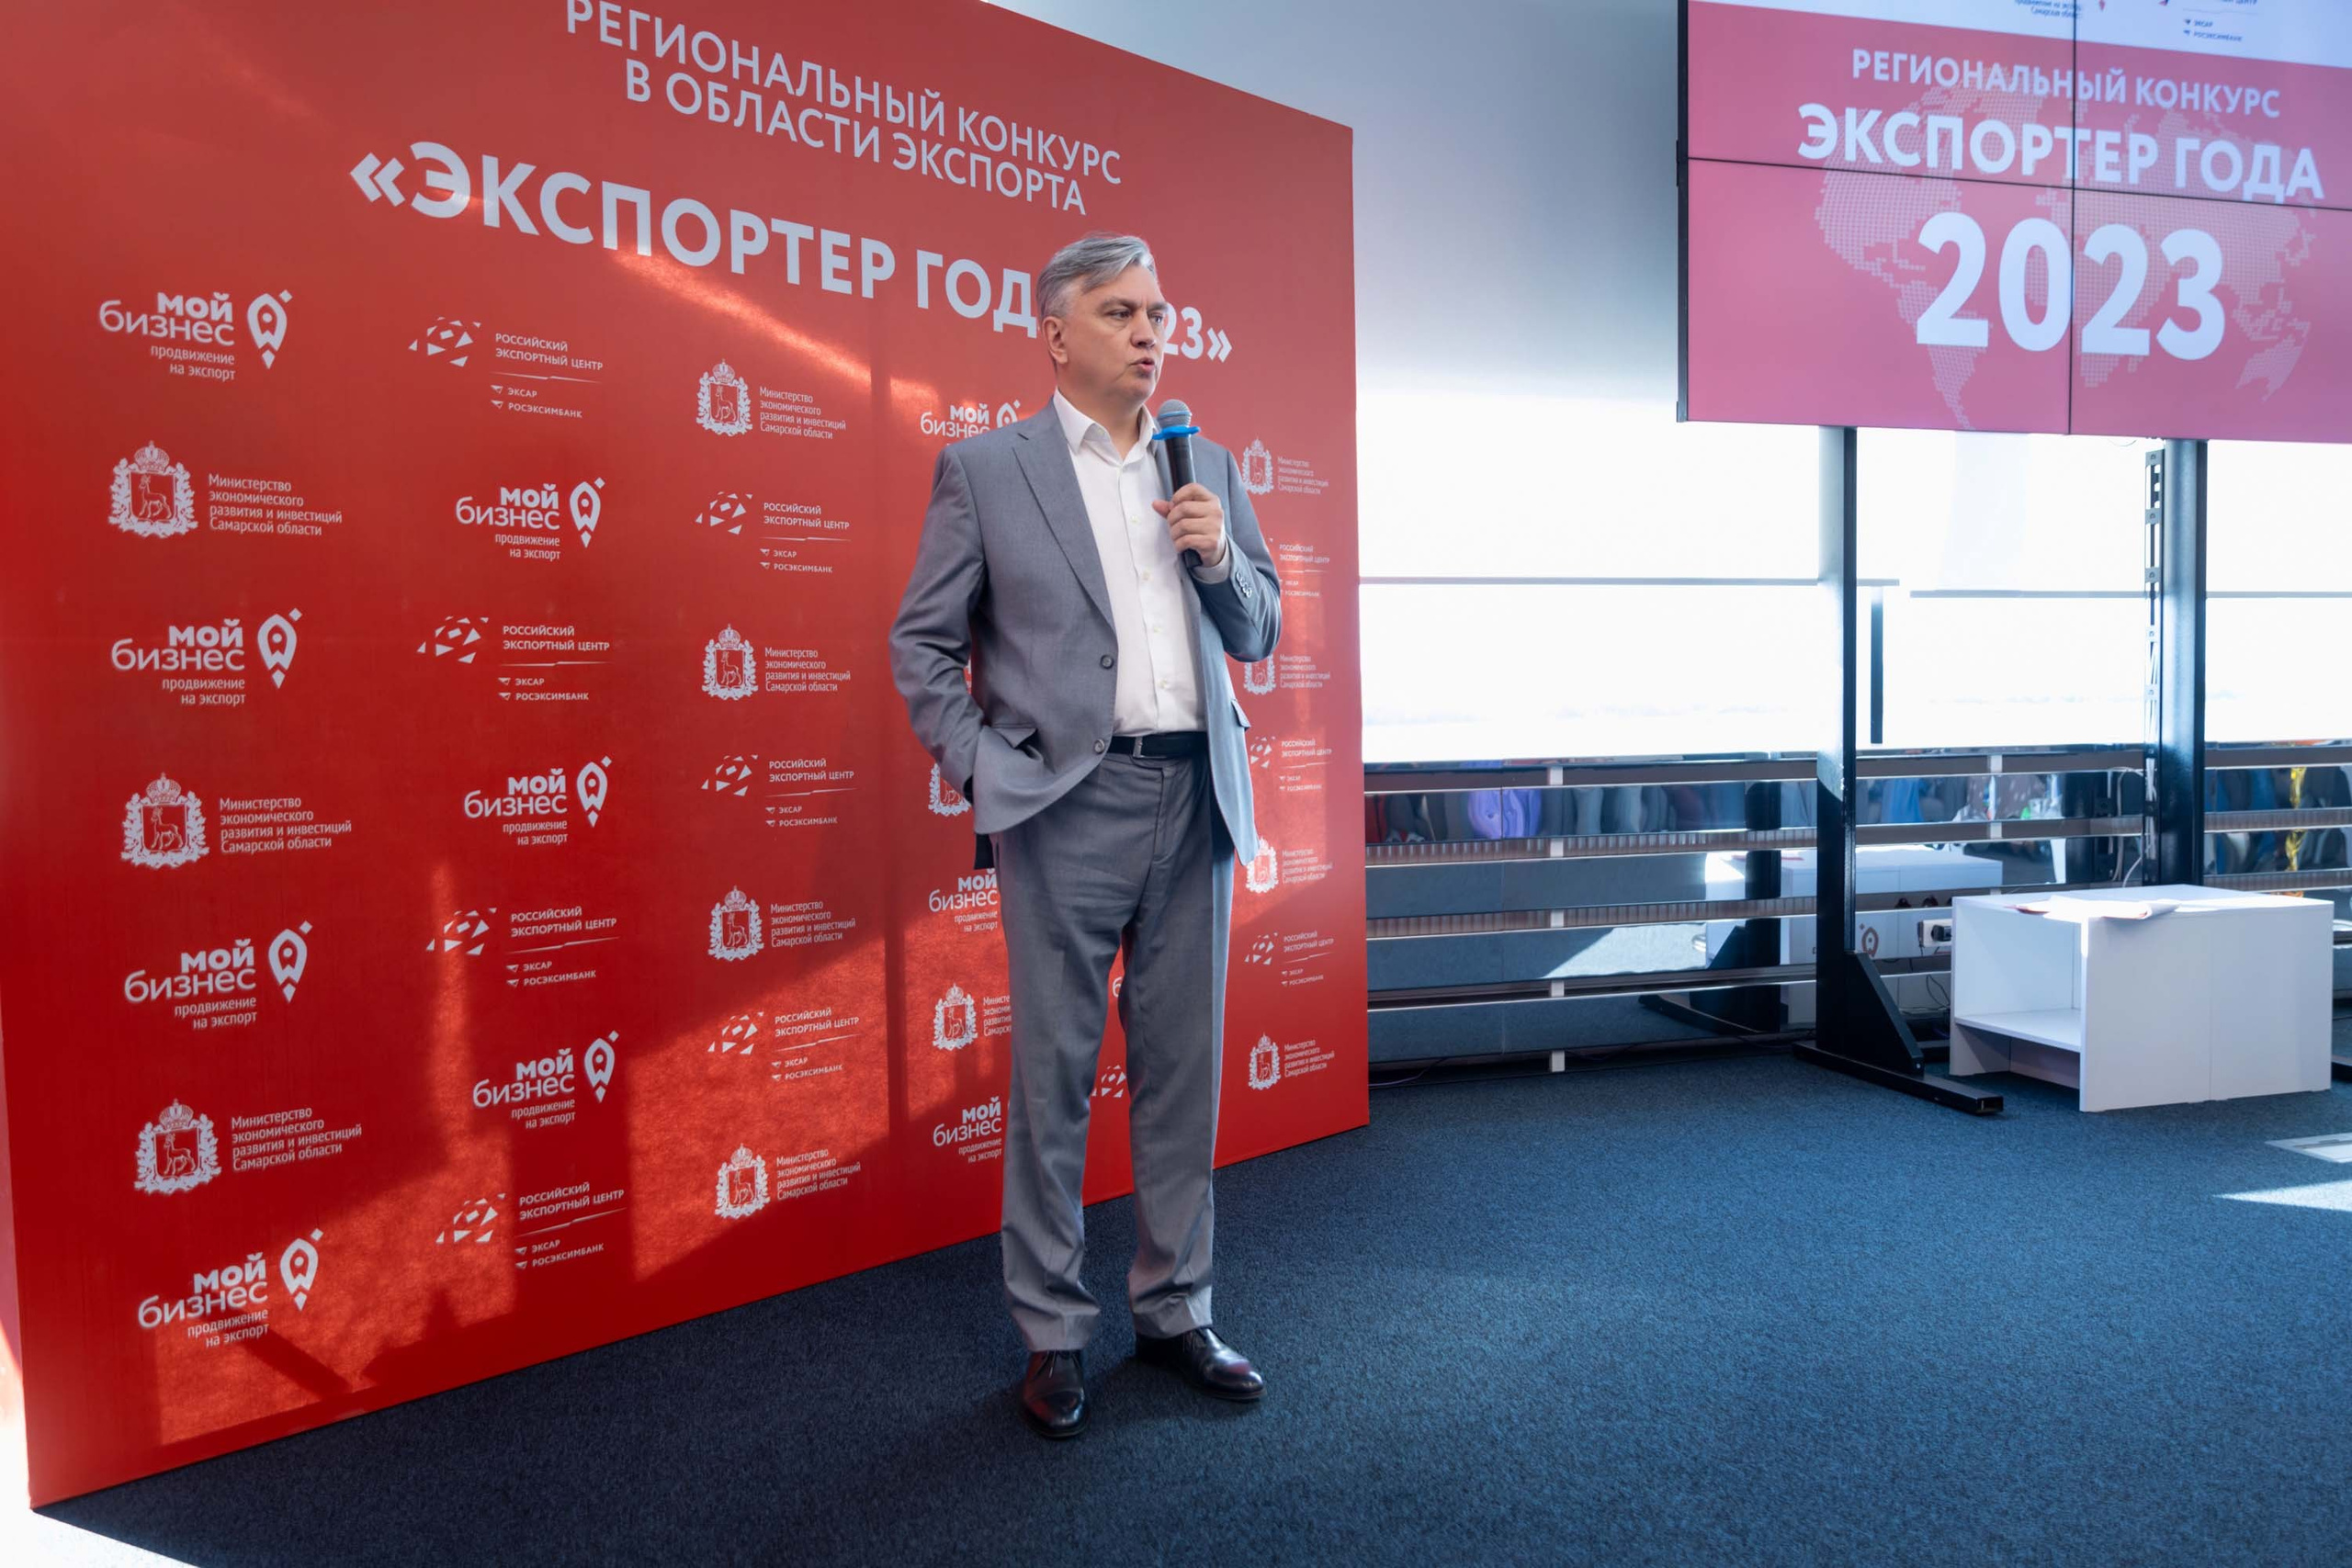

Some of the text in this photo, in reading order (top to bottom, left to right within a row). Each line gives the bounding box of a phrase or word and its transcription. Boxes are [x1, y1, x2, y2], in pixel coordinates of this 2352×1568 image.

[1852, 48, 2279, 118] РЕГИОНАЛЬНЫЙ КОНКУРС
[566, 0, 1122, 185] РЕГИОНАЛЬНЫЙ КОНКУРС
[626, 58, 1086, 216] В ОБЛАСТИ ЭКСПОРТА
[1797, 102, 2324, 204] ЭКСПОРТЕР ГОДА
[349, 141, 896, 300] «ЭКСПОРТЕР
[916, 249, 1037, 339] ГОД
[1916, 211, 2225, 361] 2023
[157, 291, 233, 322] мой
[99, 299, 235, 346] бизнес
[495, 333, 568, 352] РОССИЙСКИЙ
[151, 346, 235, 365] продвижение
[496, 348, 603, 370] ЭКСПОРТНЫЙ ЦЕНТР
[170, 364, 235, 381] на экспорт
[508, 388, 537, 398] ЭКСАР
[759, 386, 813, 403] Министерство
[508, 402, 582, 418] РОСЭКСИМБАНК
[760, 400, 821, 416] экономического
[950, 403, 989, 425] мой
[760, 412, 795, 423] развития
[803, 417, 846, 430] инвестиций
[760, 422, 833, 439] Самарской области
[209, 473, 291, 492] Министерство
[209, 491, 304, 507] экономического
[501, 483, 559, 510] мой
[209, 505, 263, 518] развития
[277, 510, 342, 524] инвестиций
[456, 496, 560, 530] бизнес
[763, 502, 821, 515] РОССИЙСКИЙ
[209, 517, 322, 536] Самарской области
[763, 515, 849, 530] ЭКСПОРТНЫЙ ЦЕНТР
[495, 535, 560, 547] продвижение
[510, 548, 560, 561] на экспорт
[774, 563, 832, 573] РОСЭКСИМБАНК
[169, 618, 243, 648] мой
[503, 625, 574, 636] РОССИЙСКИЙ
[111, 637, 245, 671] бизнес
[503, 640, 609, 651] ЭКСПОРТНЫЙ ЦЕНТР
[765, 647, 818, 660] Министерство
[765, 660, 826, 670] экономического
[163, 679, 245, 692] продвижение
[765, 672, 799, 682] развития
[808, 671, 851, 682] инвестиций
[515, 693, 589, 701] РОСЭКСИМБАНК
[765, 682, 837, 694] Самарской области
[181, 694, 246, 706] на экспорт
[769, 758, 826, 769] РОССИЙСКИЙ
[508, 768, 566, 795] мой
[769, 771, 854, 783] ЭКСПОРТНЫЙ ЦЕНТР
[220, 797, 301, 811] Министерство
[464, 790, 568, 818] бизнес
[779, 806, 802, 814] ЭКСАР
[220, 811, 314, 825] экономического
[779, 817, 837, 827] РОСЭКСИМБАНК
[220, 827, 274, 841] развития
[287, 820, 352, 835] инвестиций
[503, 820, 568, 835] продвижение
[220, 838, 332, 854] Самарской области
[517, 834, 568, 845] на экспорт
[771, 901, 823, 914] Министерство
[929, 888, 998, 912] бизнес
[512, 906, 582, 922] РОССИЙСКИЙ
[772, 911, 831, 926] экономического
[955, 910, 998, 924] продвижение
[512, 918, 616, 937] ЭКСПОРТНЫЙ ЦЕНТР
[771, 925, 805, 939] развития
[813, 918, 855, 931] инвестиций
[964, 921, 998, 932] на экспорт
[771, 932, 842, 948] Самарской области
[181, 938, 255, 973] мой
[524, 962, 552, 972] ЭКСАР
[124, 967, 257, 1002] бизнес
[524, 971, 595, 986] РОСЭКСИМБАНК
[175, 997, 257, 1018] продвижение
[983, 995, 1010, 1007] Министе
[193, 1011, 257, 1028] на экспорт
[775, 1007, 831, 1024] РОССИЙСКИЙ
[775, 1017, 859, 1037] ЭКСПОРТНЫЙ ЦЕНТР
[516, 1047, 573, 1081] мой
[785, 1057, 808, 1067] ЭКСАР
[785, 1064, 842, 1080] РОСЭКСИМБАНК
[472, 1074, 575, 1108] бизнес
[232, 1108, 312, 1129] Министерство
[511, 1100, 575, 1120] продвижение
[526, 1112, 575, 1129] на экспорт
[232, 1120, 324, 1144] экономического
[933, 1117, 1001, 1146] бизнес
[232, 1140, 285, 1160] развития
[298, 1124, 362, 1145] инвестиций
[958, 1138, 1001, 1156] продвижение
[232, 1144, 342, 1171] Самарской области
[776, 1148, 829, 1167] Министерство
[968, 1148, 1002, 1163] на экспорт
[777, 1157, 837, 1179] экономического
[777, 1175, 810, 1191] развития
[820, 1161, 861, 1179] инвестиций
[520, 1181, 590, 1205] РОССИЙСКИЙ
[776, 1177, 848, 1201] Самарской области
[520, 1190, 624, 1220] ЭКСПОРТНЫЙ ЦЕНТР
[532, 1239, 560, 1252] ЭКСАР
[532, 1244, 604, 1267] РОСЭКСИМБАНК
[193, 1252, 266, 1294] мой
[138, 1281, 267, 1329] бизнес
[187, 1310, 267, 1338] продвижение
[206, 1324, 268, 1348] на экспорт
